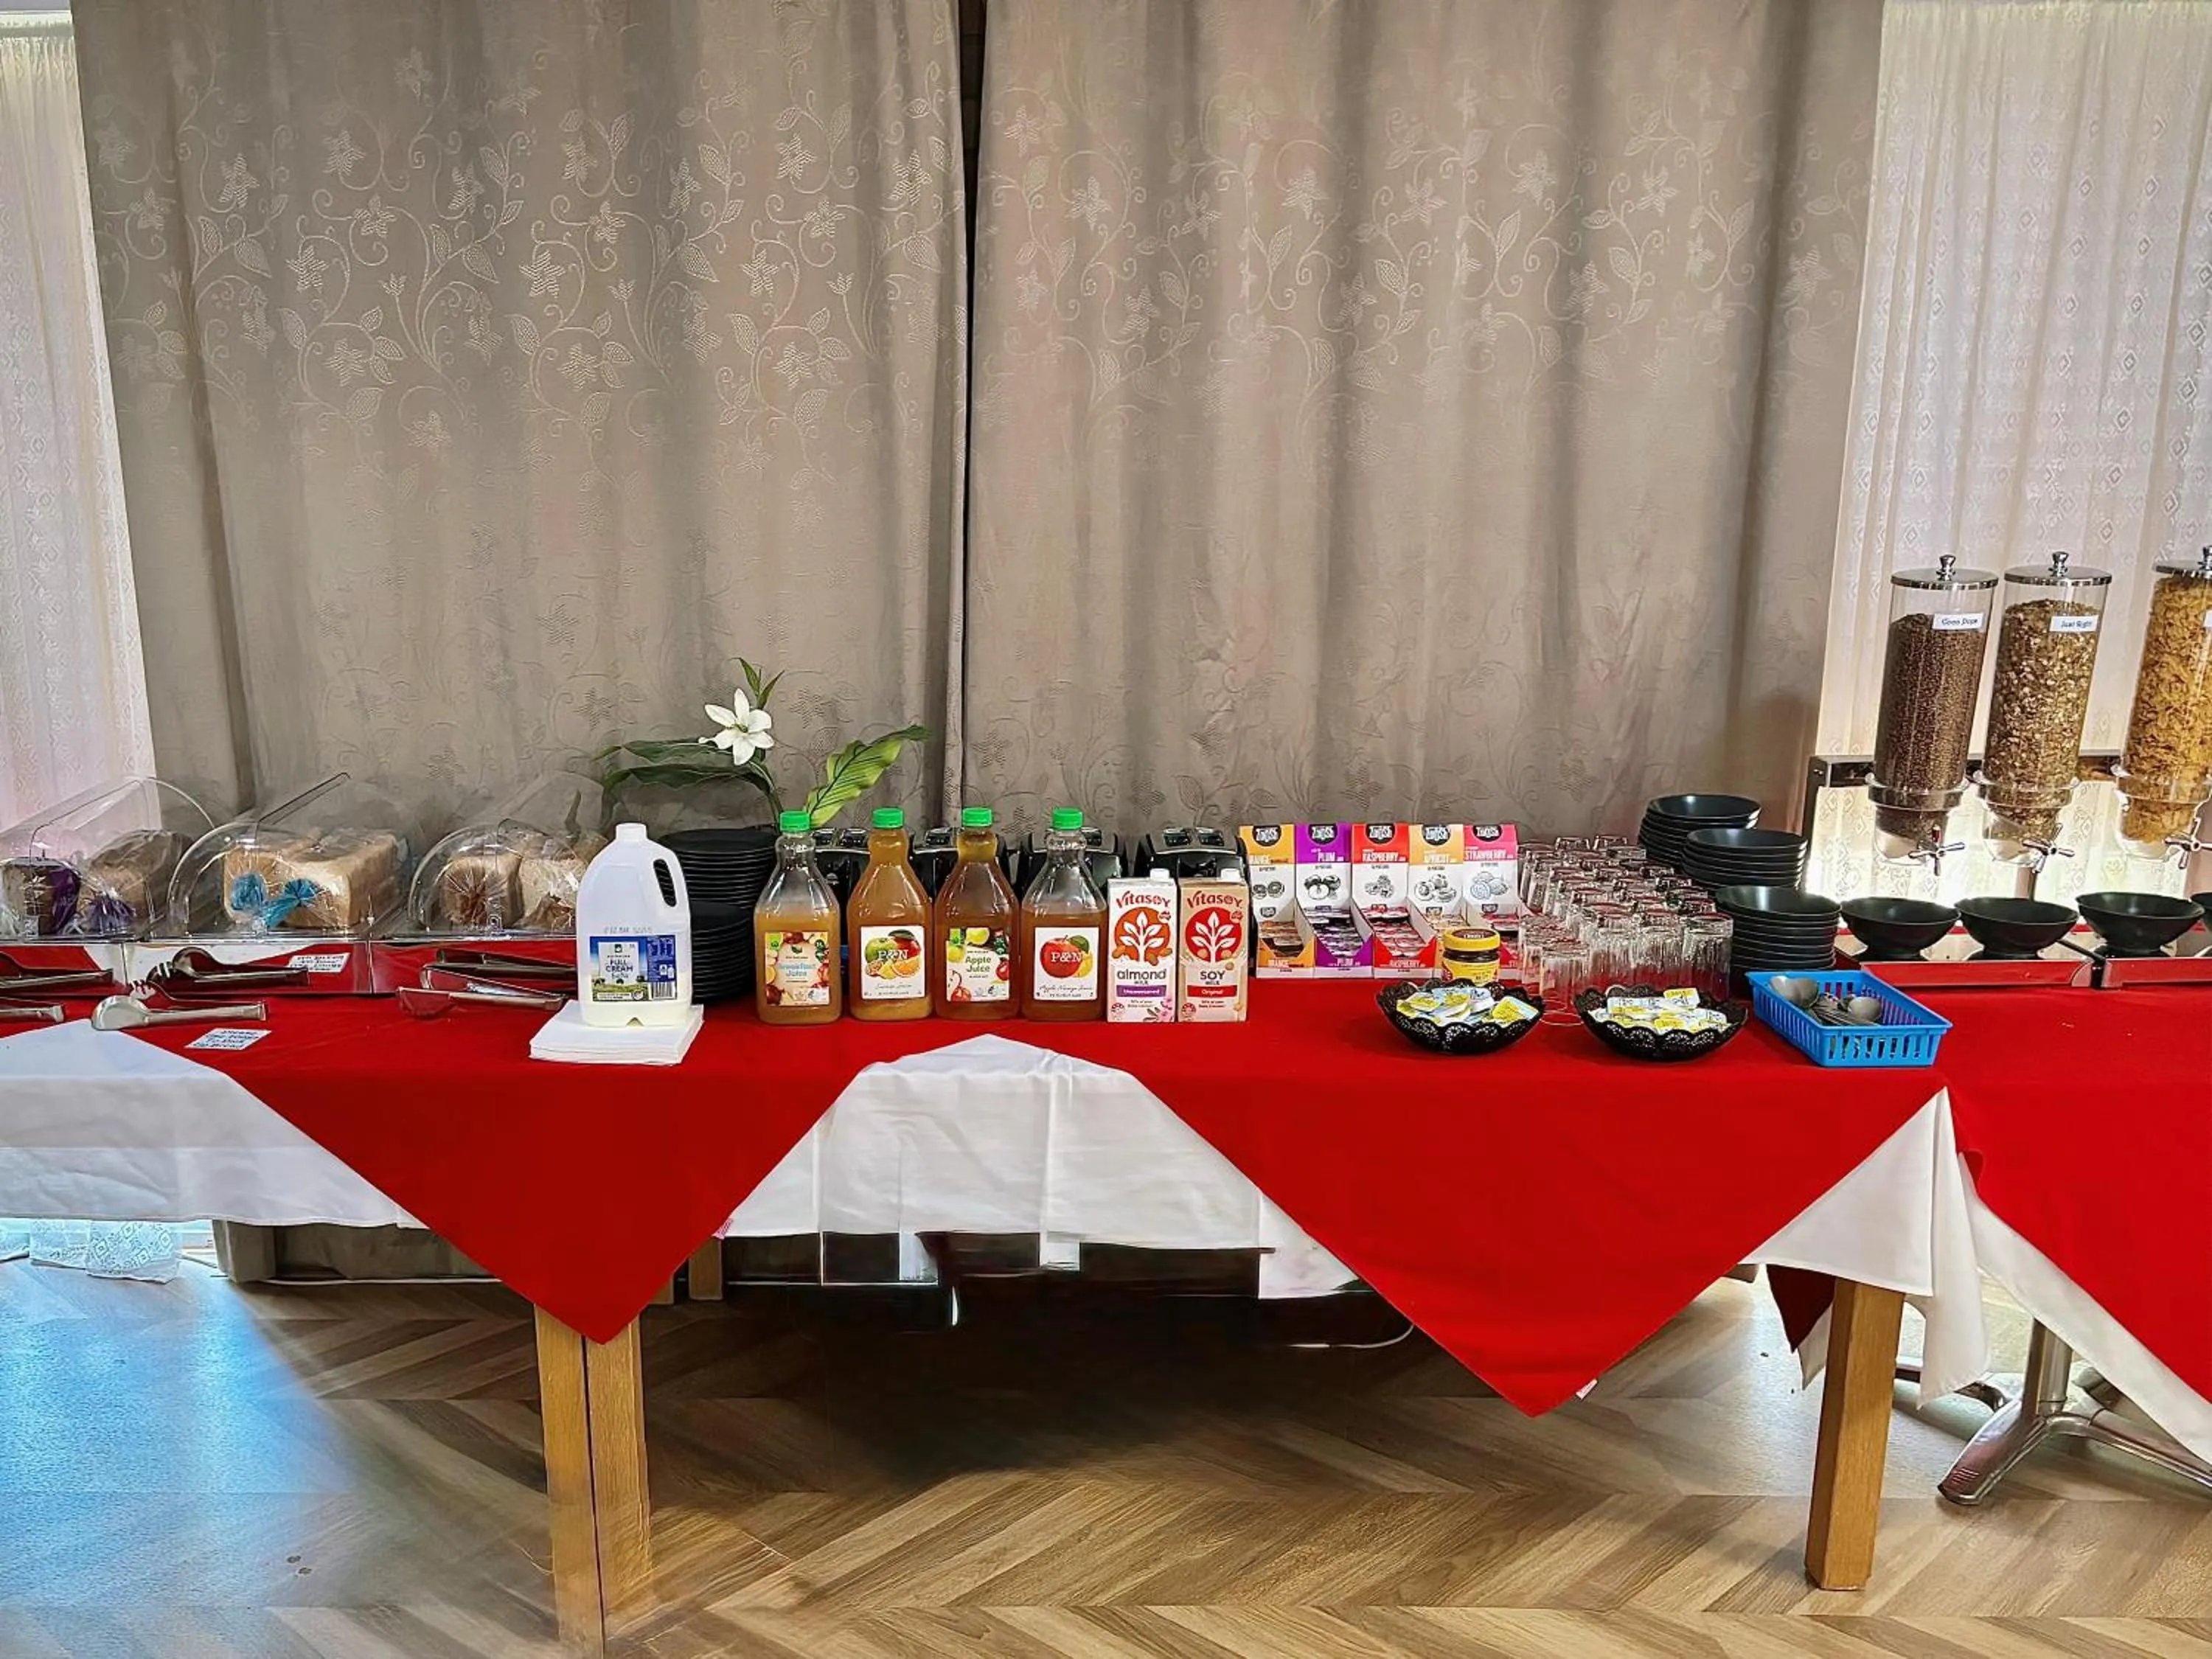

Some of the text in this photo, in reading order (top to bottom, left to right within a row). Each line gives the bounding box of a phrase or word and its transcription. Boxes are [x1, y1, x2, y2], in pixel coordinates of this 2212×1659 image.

[878, 949, 909, 961] P&N
[966, 956, 992, 964] Apple
[1050, 951, 1084, 963] P&N
[1117, 968, 1166, 980] almond
[1200, 970, 1225, 980] SOY
